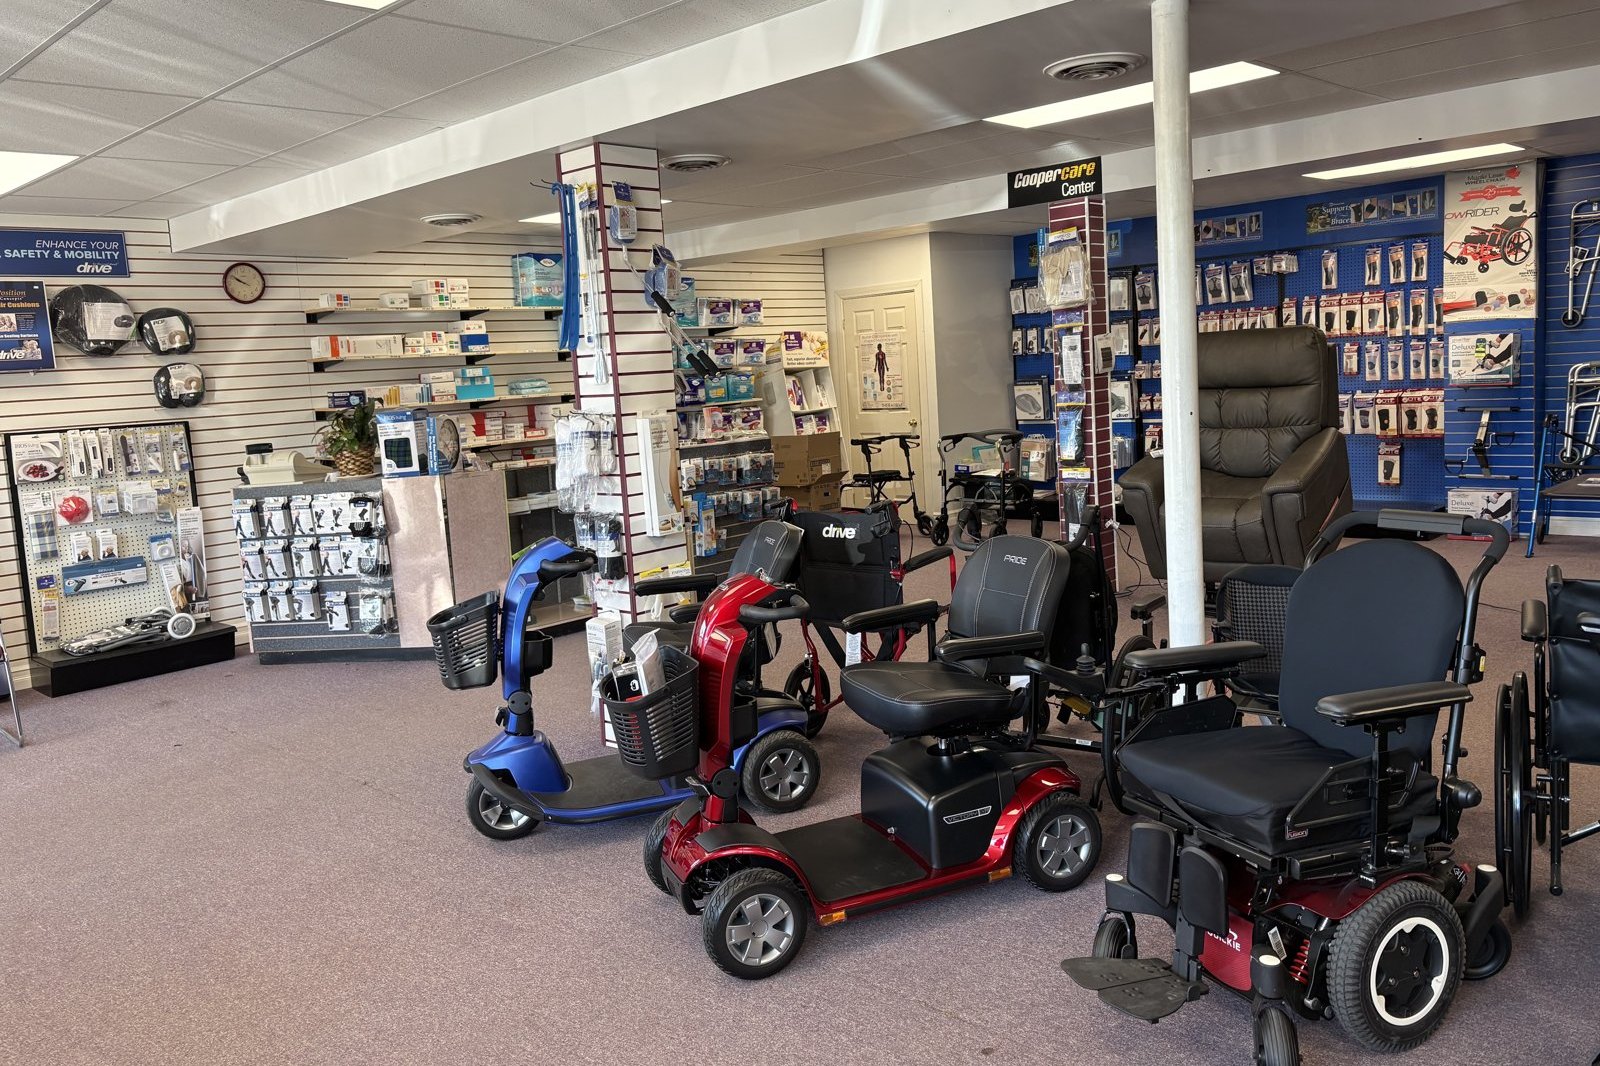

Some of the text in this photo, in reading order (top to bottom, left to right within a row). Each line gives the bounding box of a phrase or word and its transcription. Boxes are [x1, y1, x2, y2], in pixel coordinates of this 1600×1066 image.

[1013, 161, 1096, 189] Coopercare
[1061, 181, 1096, 197] Center
[35, 239, 119, 250] ENHANCE YOUR
[4, 249, 120, 260] SAFETY & MOBILITY
[76, 262, 112, 273] drive
[822, 523, 856, 539] drive
[1003, 554, 1028, 566] PRIDE
